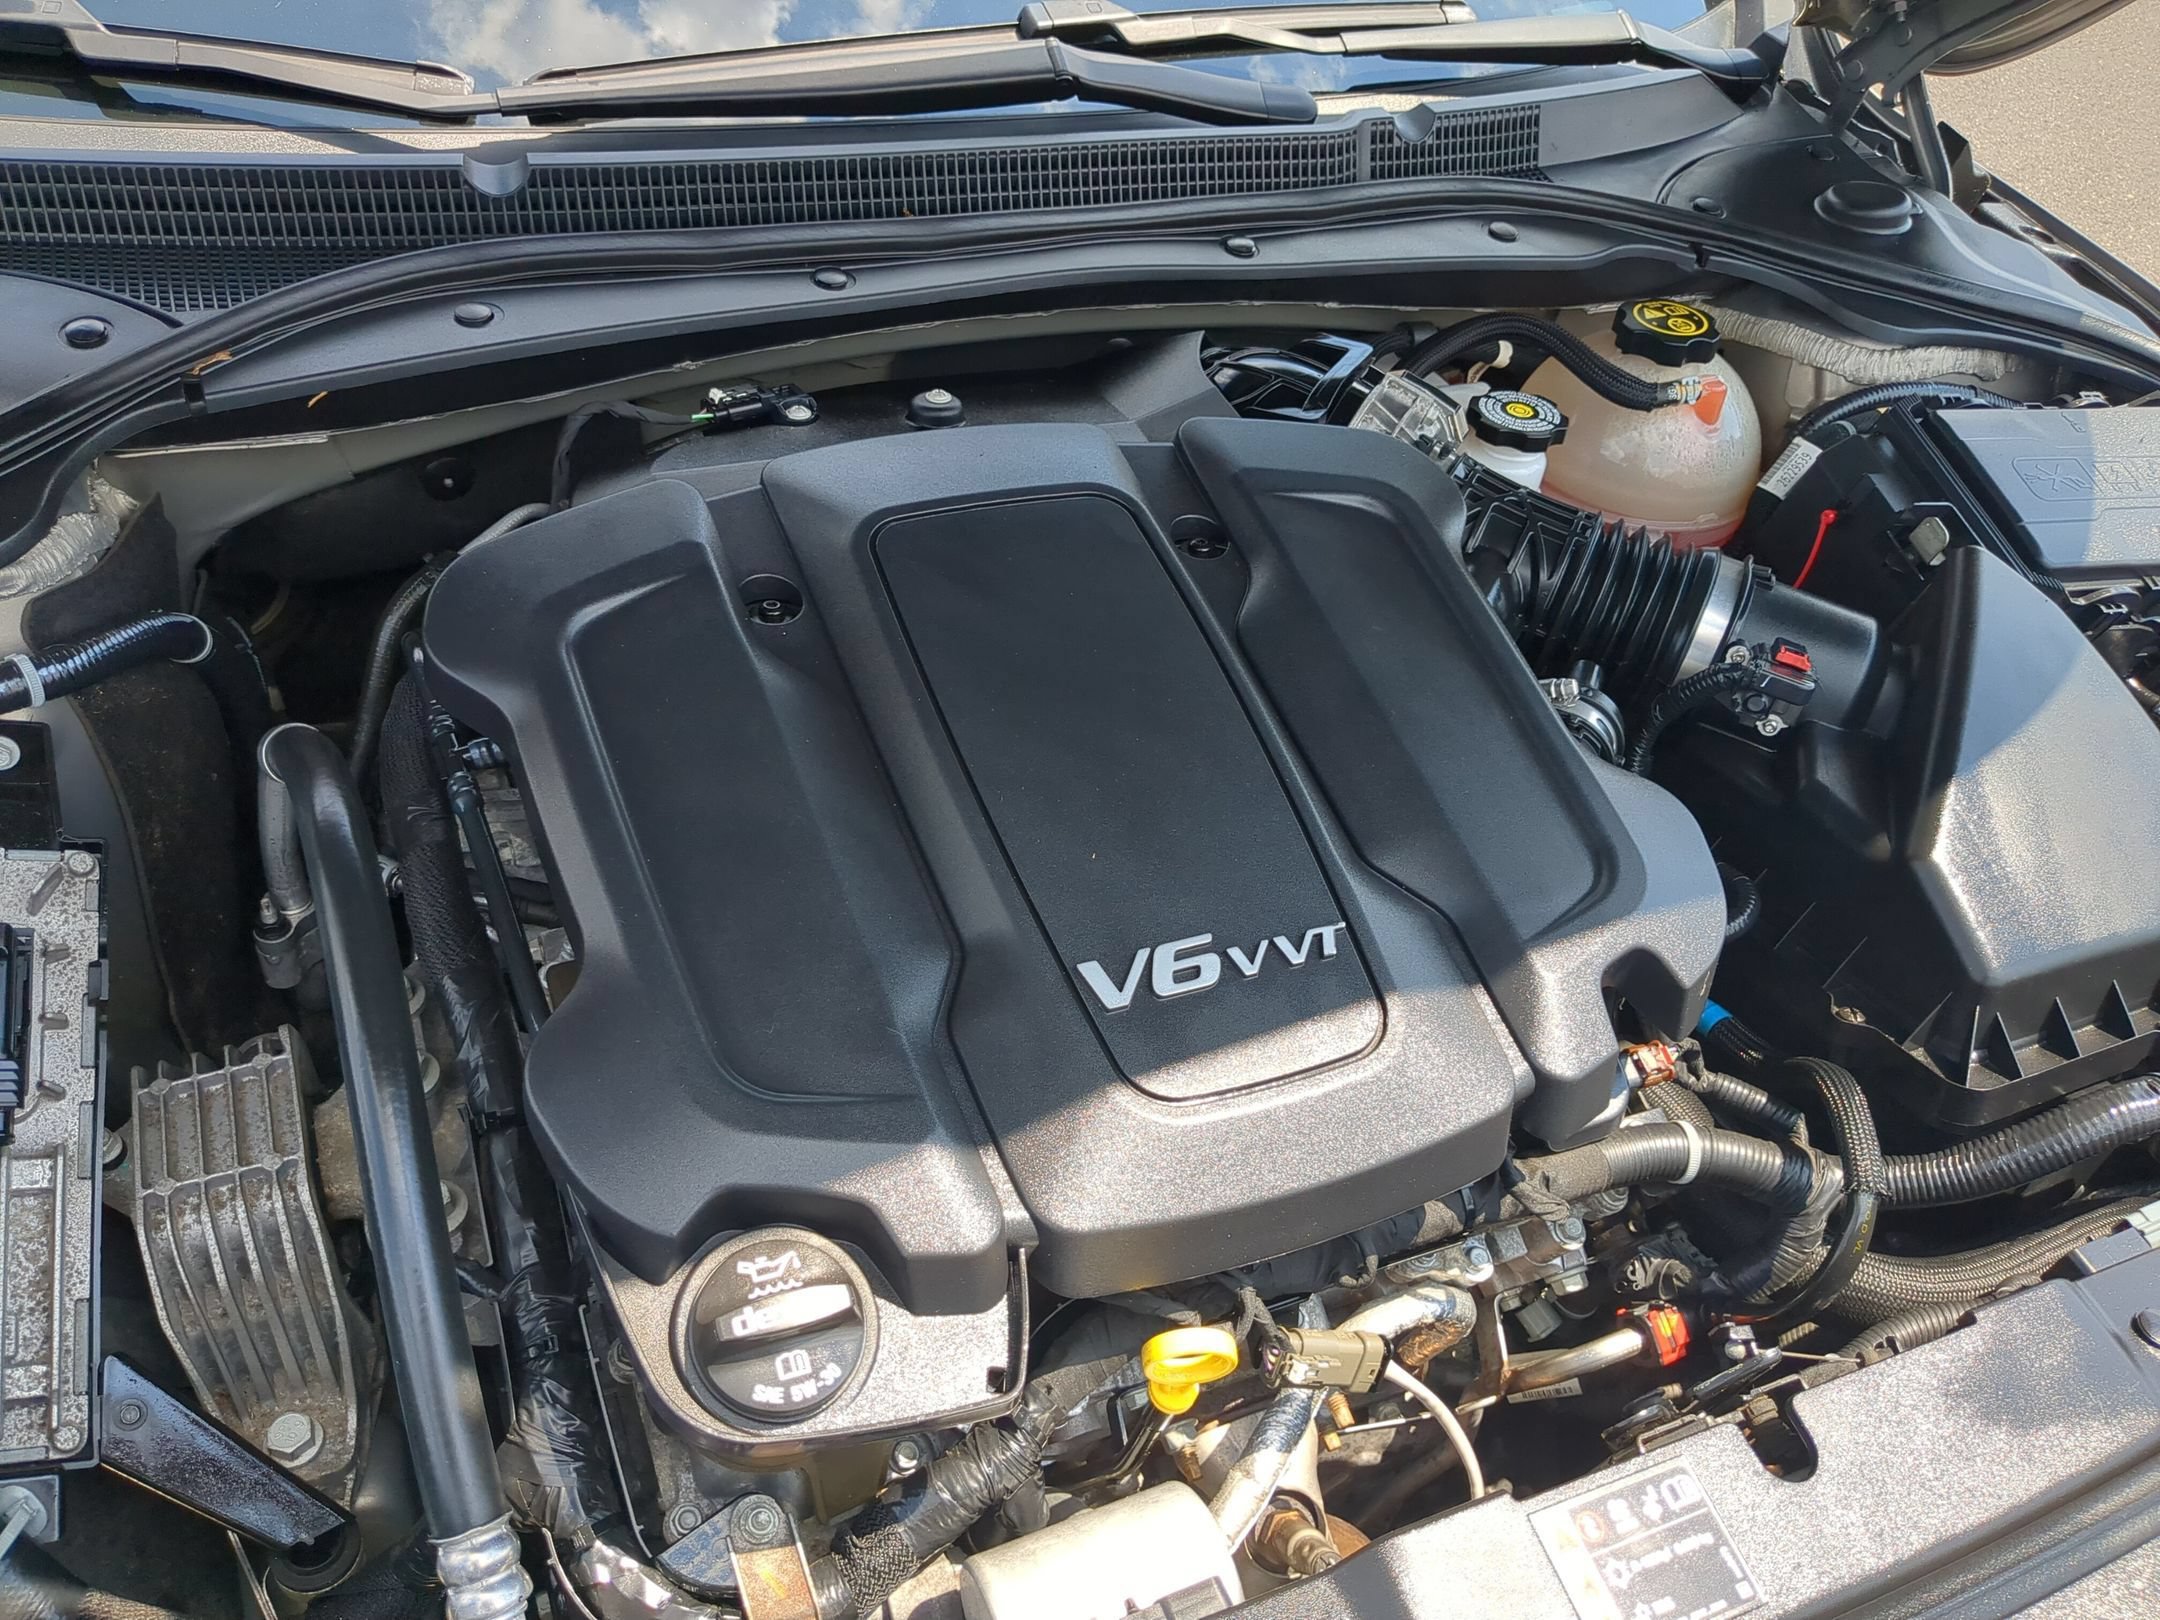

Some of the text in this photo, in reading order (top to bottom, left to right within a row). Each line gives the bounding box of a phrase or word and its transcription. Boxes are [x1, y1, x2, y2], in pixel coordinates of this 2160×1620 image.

[1076, 921, 1346, 1013] V6 VVT
[790, 1362, 842, 1402] 5W-30
